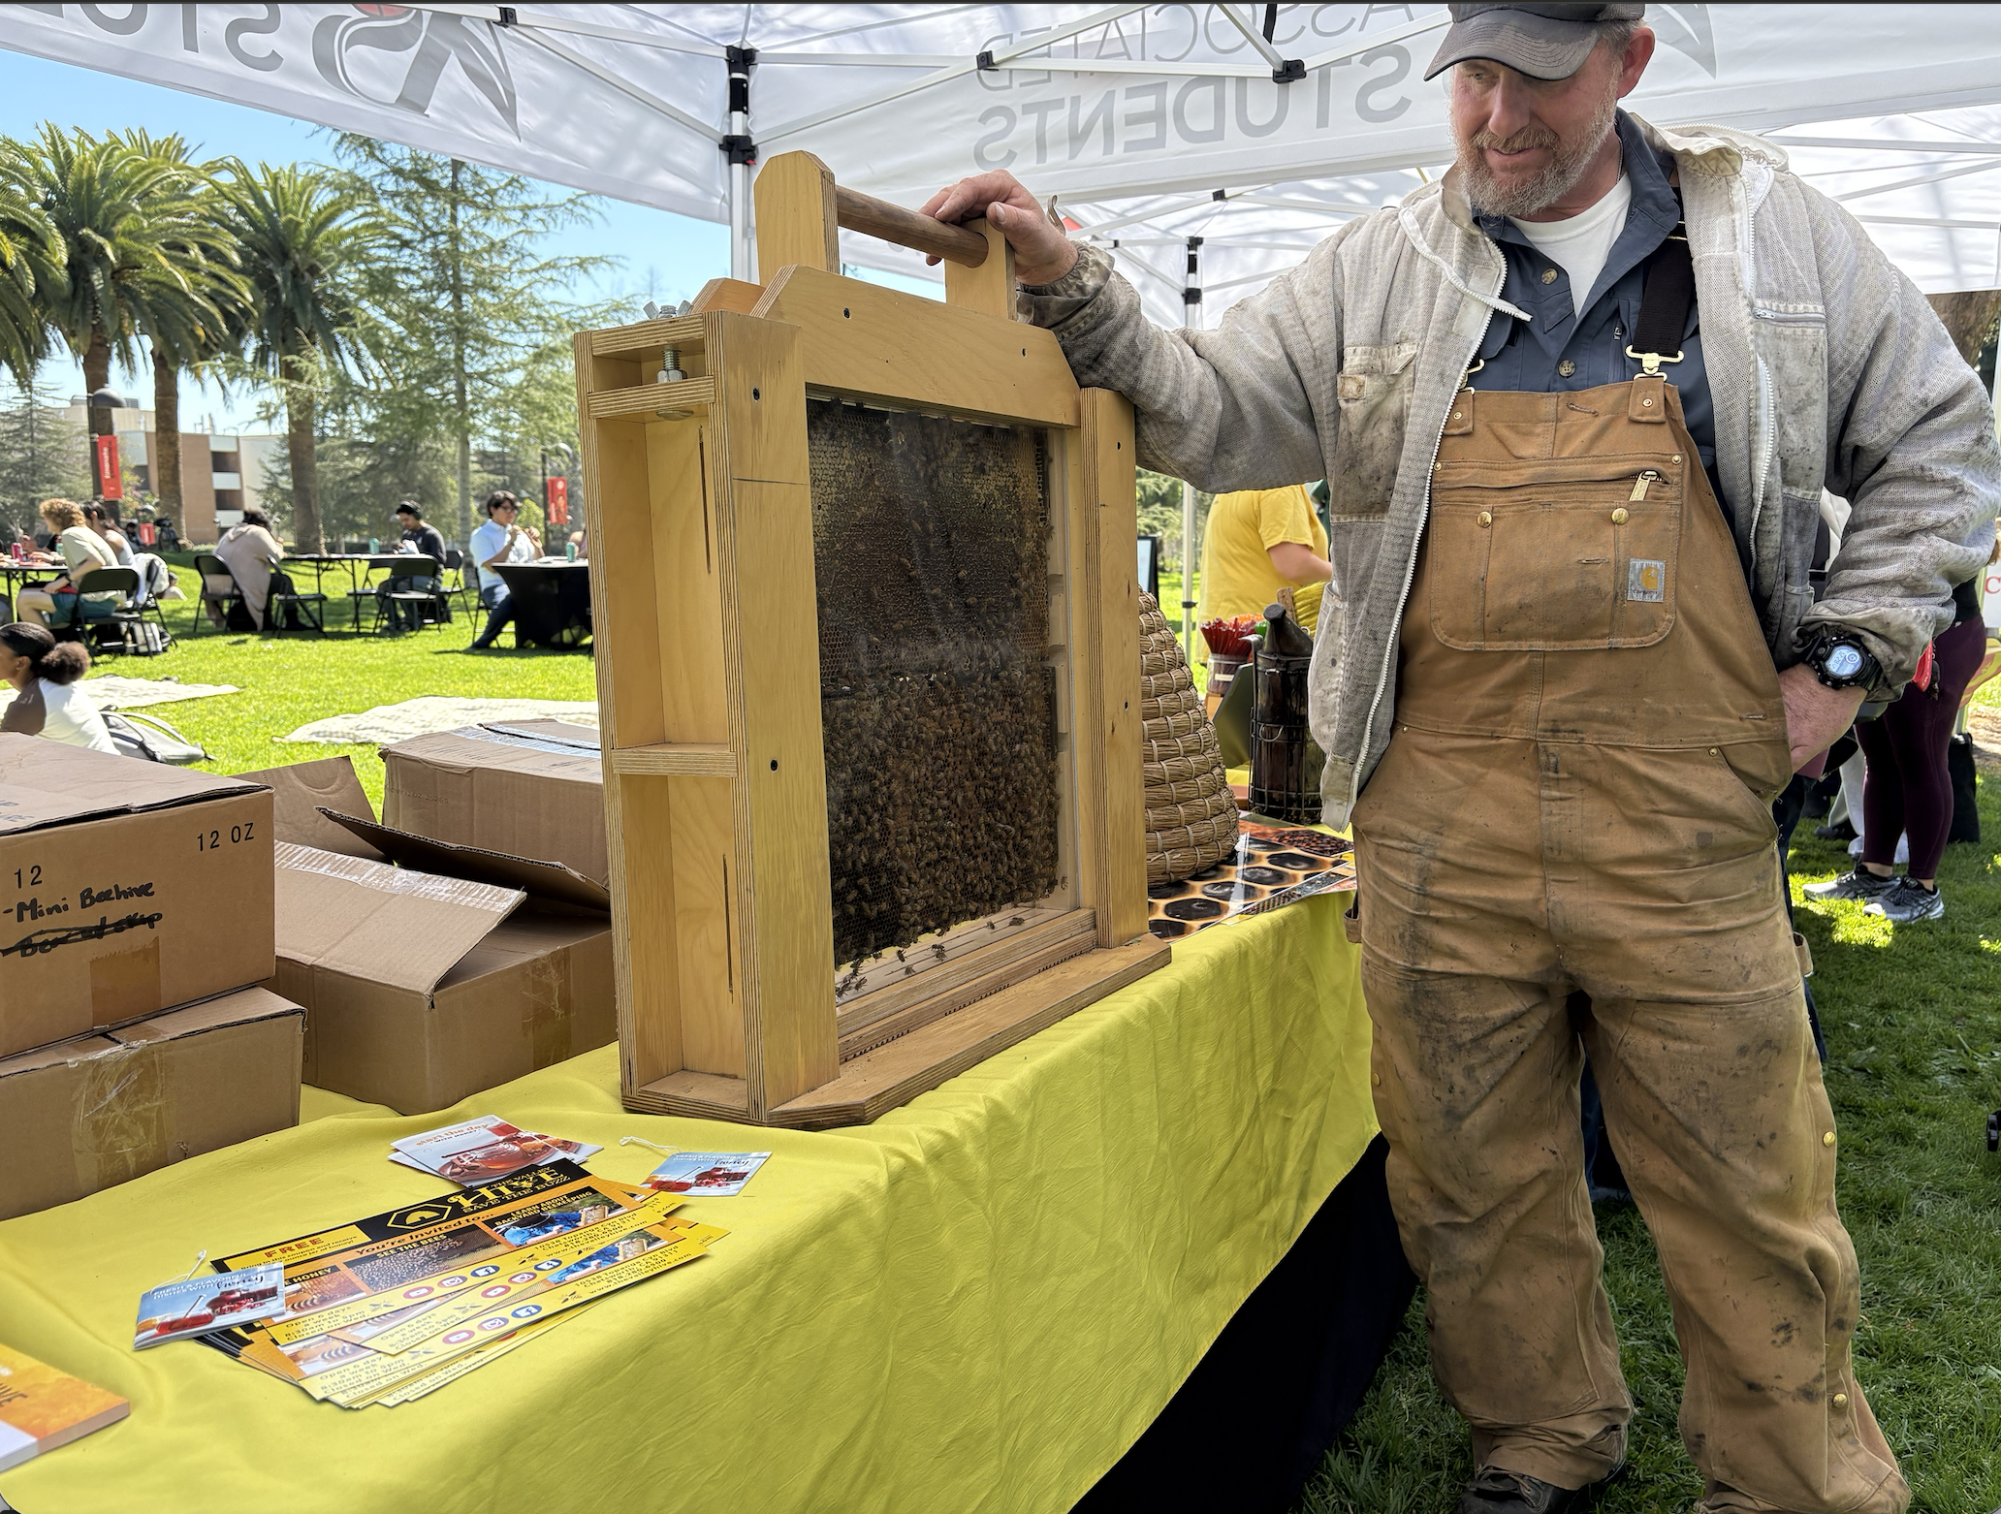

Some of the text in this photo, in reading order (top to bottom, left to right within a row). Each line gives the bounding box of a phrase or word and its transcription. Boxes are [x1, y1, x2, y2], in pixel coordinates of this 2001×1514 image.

[197, 833, 220, 851] 12
[14, 865, 43, 888] 12
[80, 882, 155, 909] Beehive
[416, 1134, 444, 1145] start
[462, 1174, 570, 1213] SAVE THE BUZZ
[495, 1192, 592, 1226] BACKYARD BEEKEEPING
[511, 1195, 568, 1217] LEARN ABOUT
[264, 1238, 324, 1258] FREE
[356, 1238, 405, 1254] You're
[410, 1221, 462, 1240] Invited
[376, 1234, 446, 1258] SEE THE BEES
[216, 1275, 264, 1289] honey
[292, 1268, 331, 1282] HONEY
[286, 1317, 314, 1328] Open
[328, 1306, 351, 1315] days
